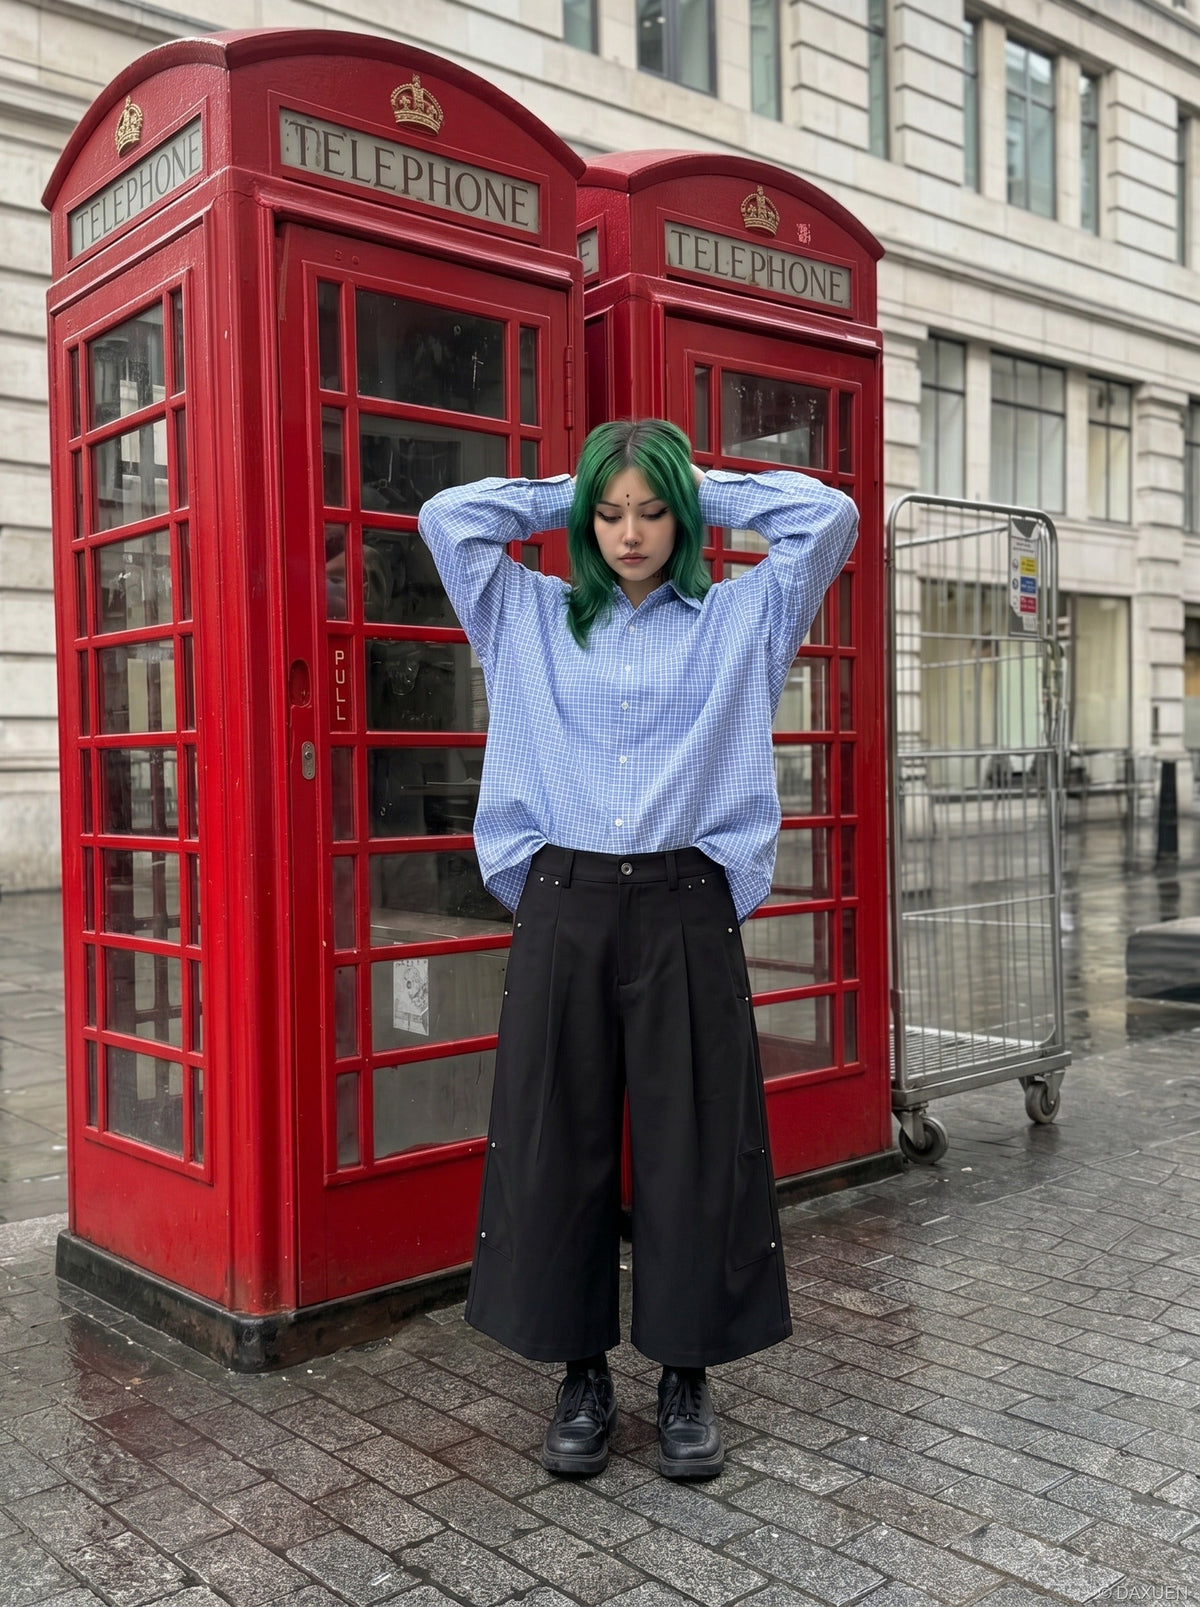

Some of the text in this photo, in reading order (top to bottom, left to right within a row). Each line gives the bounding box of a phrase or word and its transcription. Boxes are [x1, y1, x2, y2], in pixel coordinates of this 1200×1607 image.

[75, 129, 201, 251] TELEPHONE
[287, 121, 529, 227] TELEPHONE
[670, 230, 845, 304] TELEPHONE
[335, 650, 346, 721] PULL
